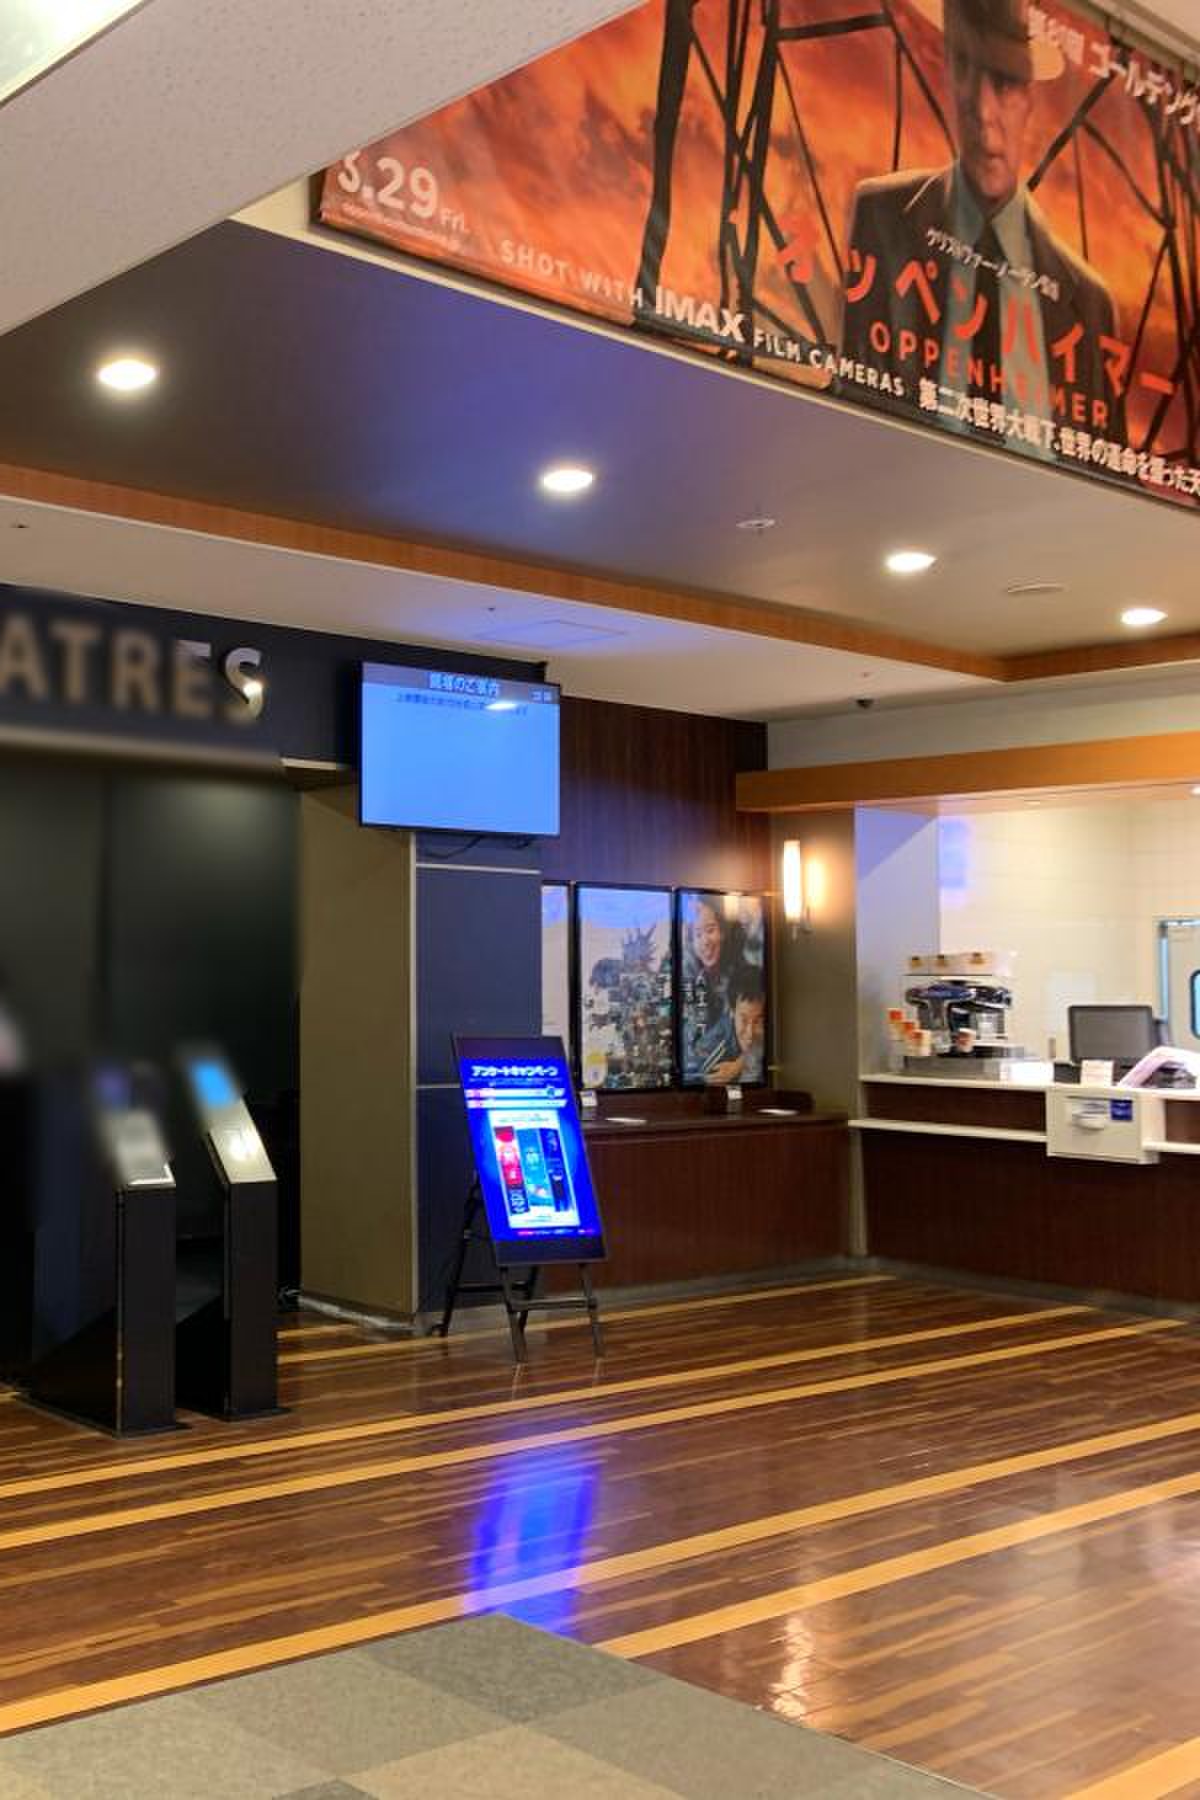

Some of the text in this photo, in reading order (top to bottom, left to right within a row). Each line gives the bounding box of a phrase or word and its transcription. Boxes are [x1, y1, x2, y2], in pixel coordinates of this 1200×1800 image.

[502, 239, 904, 396] SHOT WITH IMAX FILM CAMERAS
[776, 214, 1174, 396] オッペンハイマー
[869, 320, 1108, 428] OPPENHEIMER
